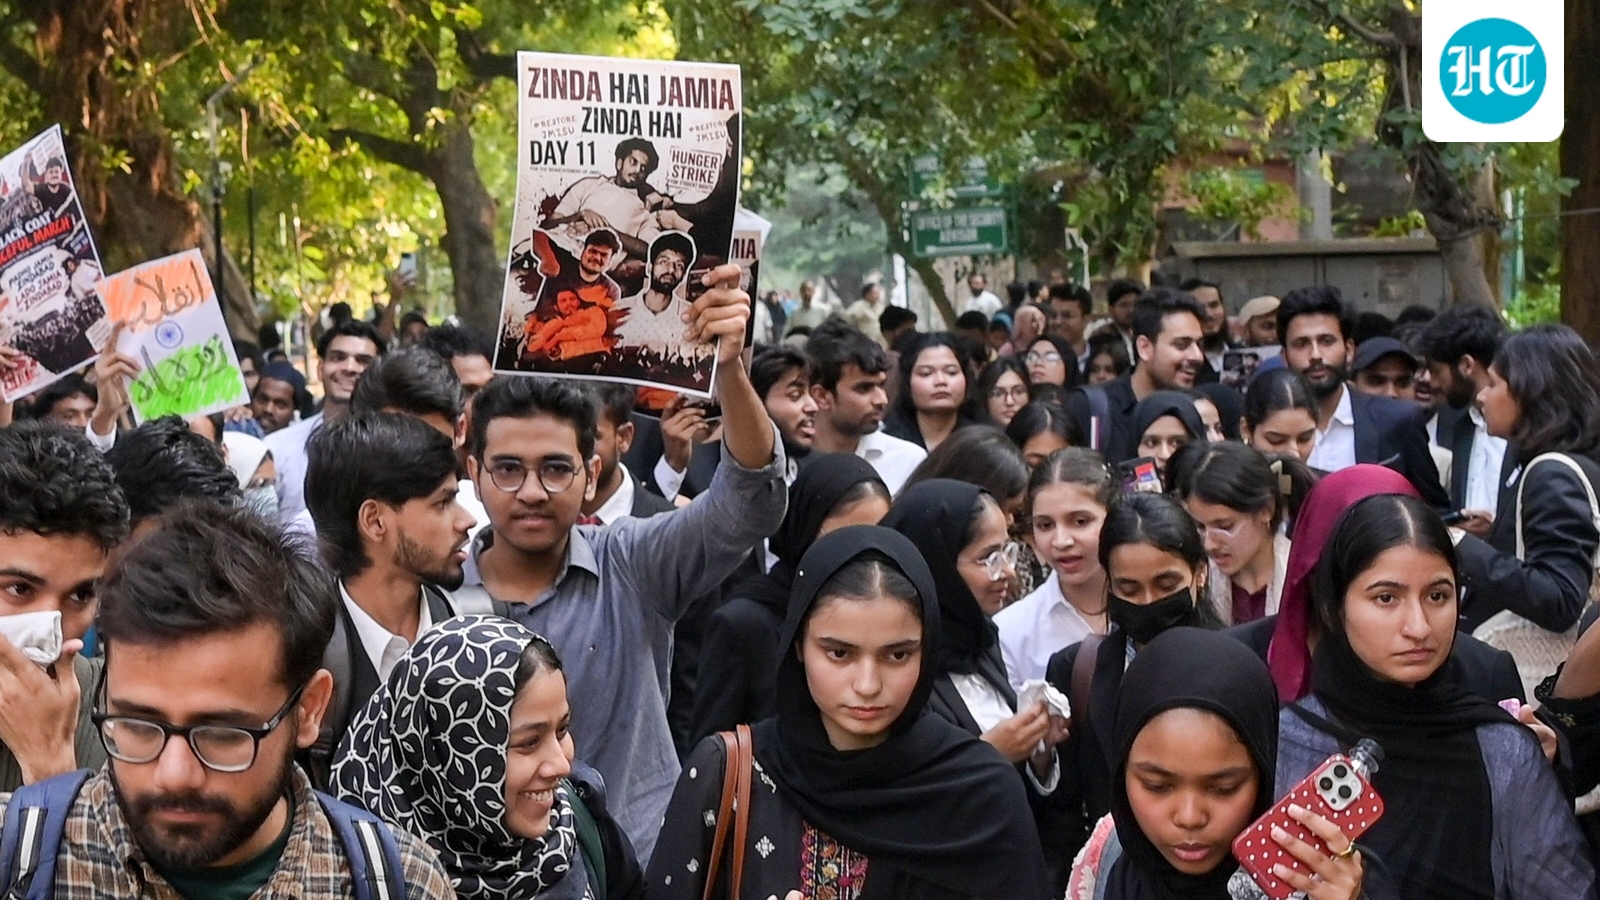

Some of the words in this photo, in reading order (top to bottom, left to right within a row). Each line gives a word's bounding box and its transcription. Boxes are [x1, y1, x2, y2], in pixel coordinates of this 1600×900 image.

[528, 66, 603, 103] ZINDA
[609, 72, 650, 106] HAI
[657, 75, 735, 111] JAMIA
[541, 126, 575, 139] JMISU
[581, 106, 642, 136] ZINDA
[648, 110, 682, 139] HAI
[696, 130, 726, 142] JMISU
[530, 140, 569, 166] DAY
[576, 140, 595, 166] 11
[672, 149, 719, 169] HUNGER
[671, 164, 715, 185] STRIKE
[25, 209, 53, 234] COAT
[33, 215, 71, 243] MARCH
[34, 252, 54, 269] JAMIA
[15, 284, 37, 308] LADO
[38, 270, 62, 290] JAMIA
[17, 261, 55, 292] ZINDABAD
[24, 280, 62, 311] ZINDABAD
